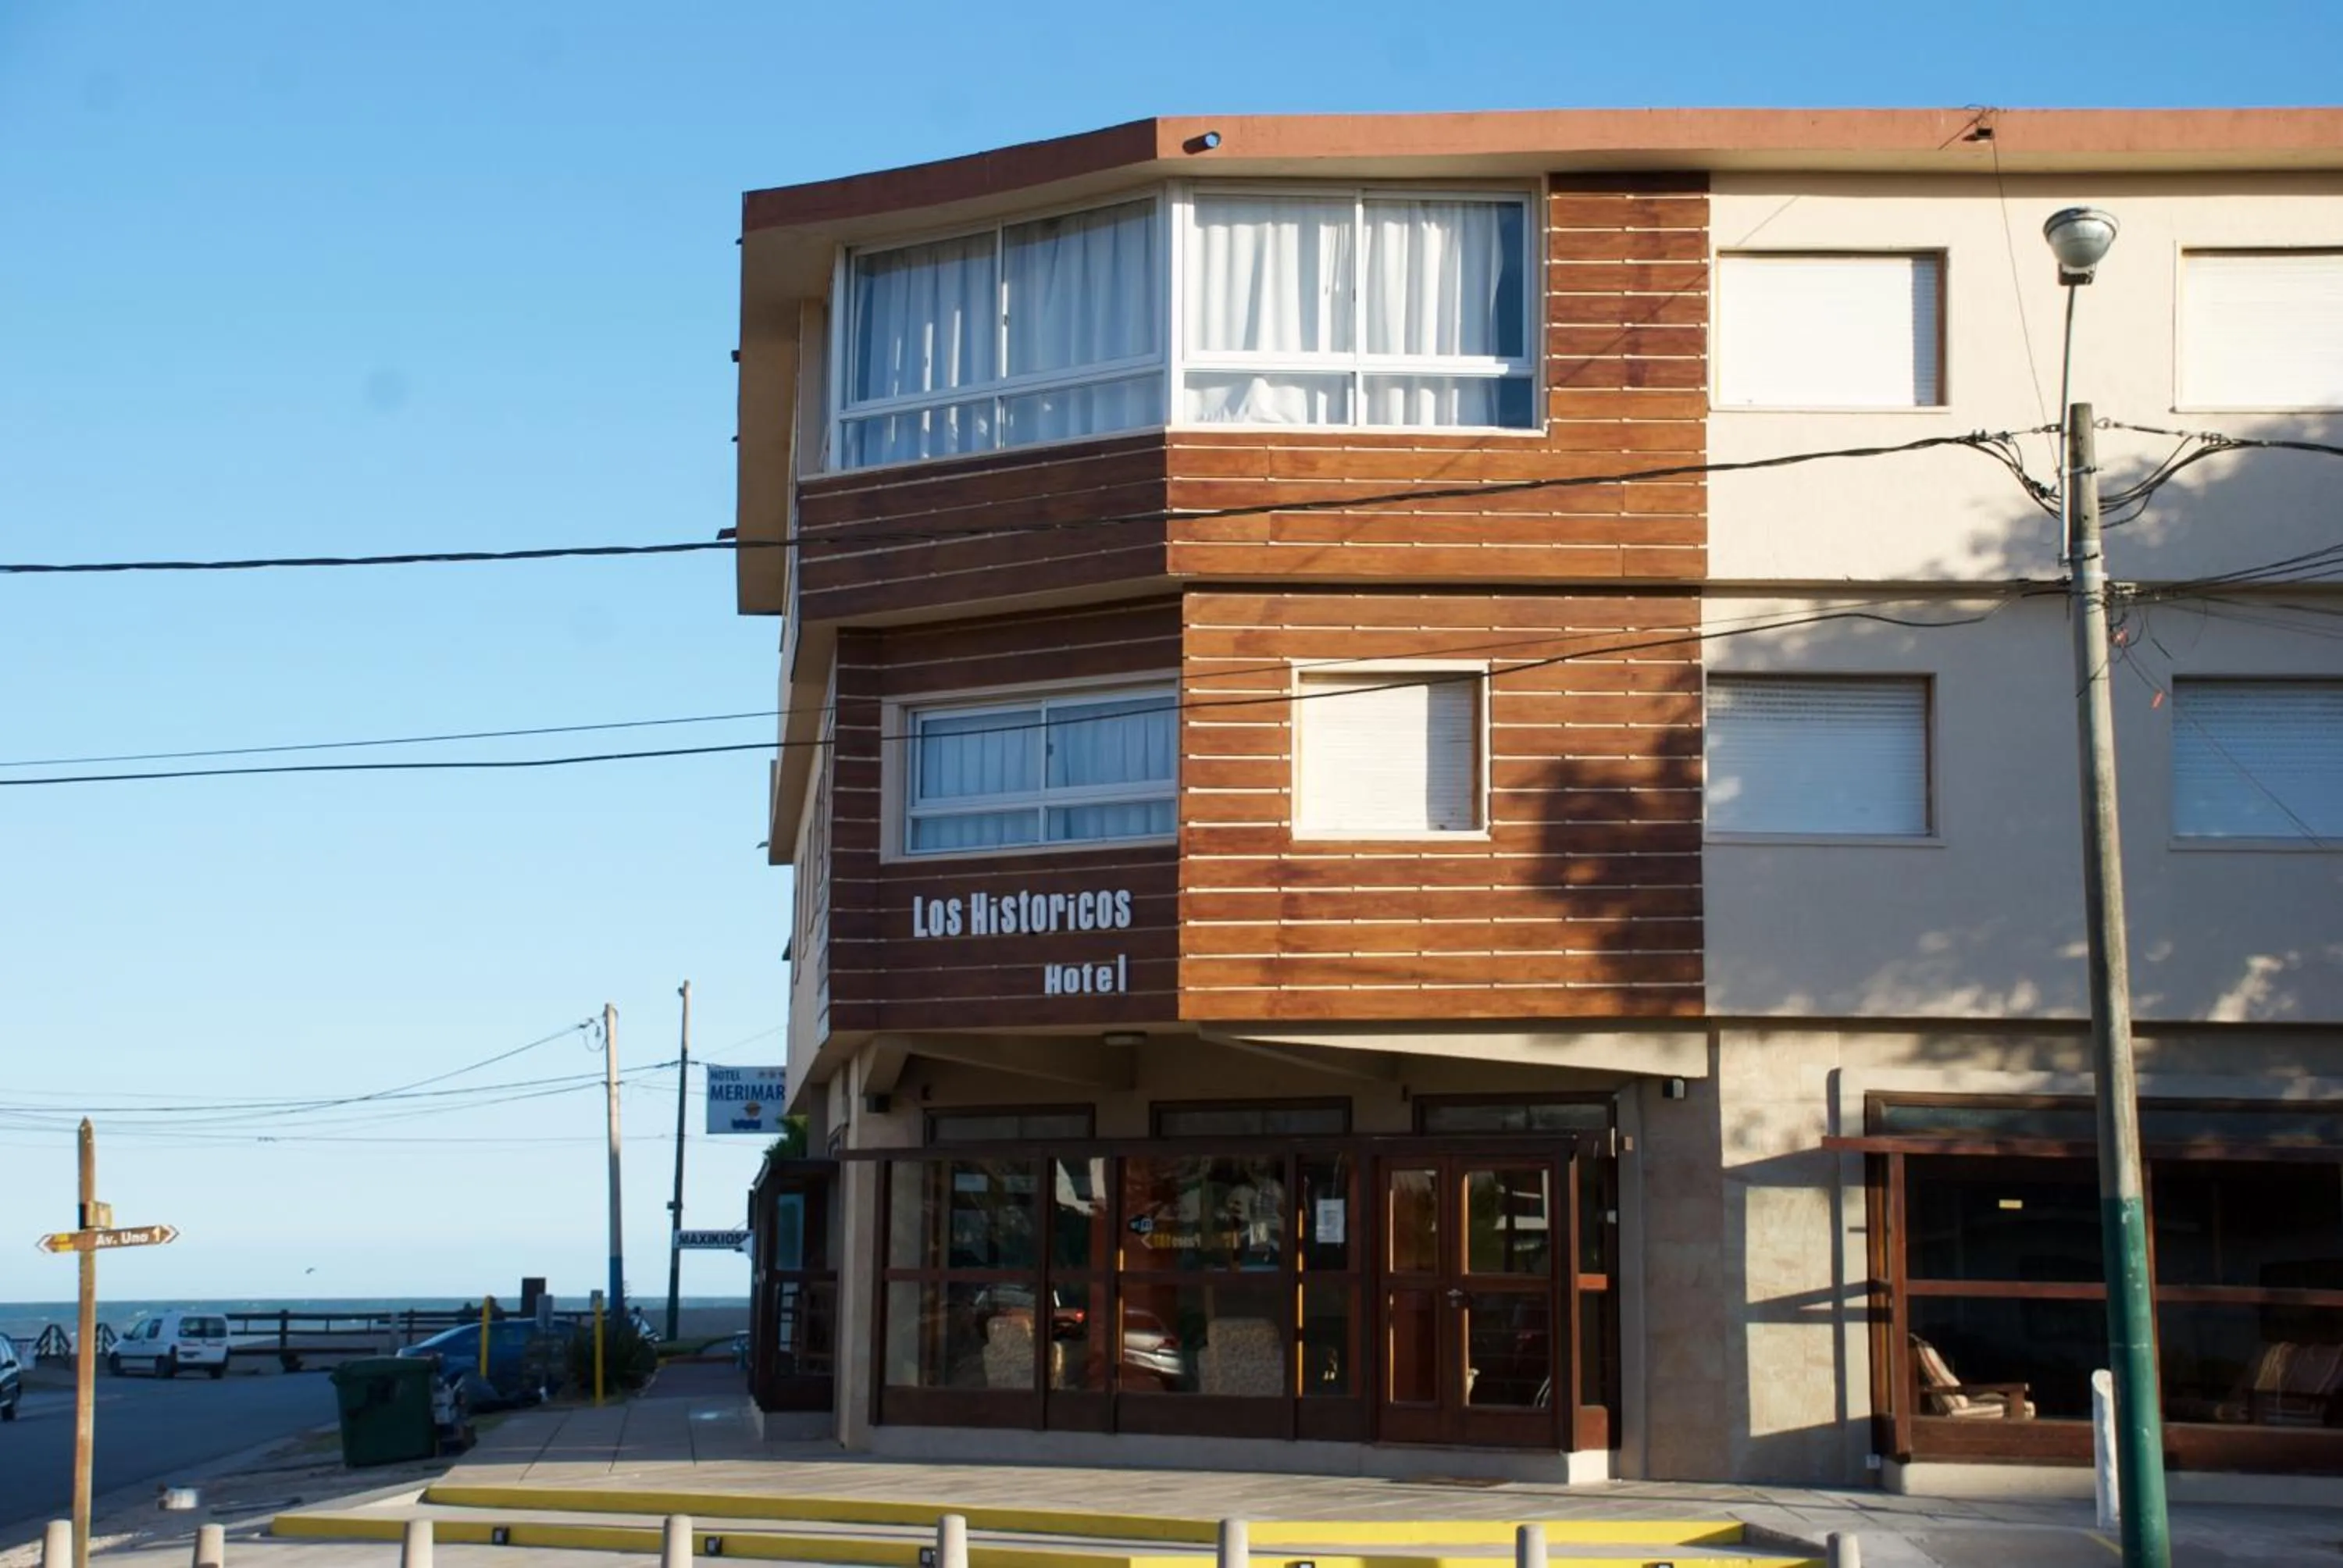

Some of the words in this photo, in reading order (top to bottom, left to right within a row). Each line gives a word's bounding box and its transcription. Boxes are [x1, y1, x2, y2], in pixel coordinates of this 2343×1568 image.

[913, 896, 962, 937] Los
[1044, 953, 1126, 994] Hotel
[710, 1070, 740, 1082] HOTEL
[710, 1084, 786, 1100] MERIMAR
[95, 1233, 117, 1246] Av.
[121, 1231, 148, 1244] Uno
